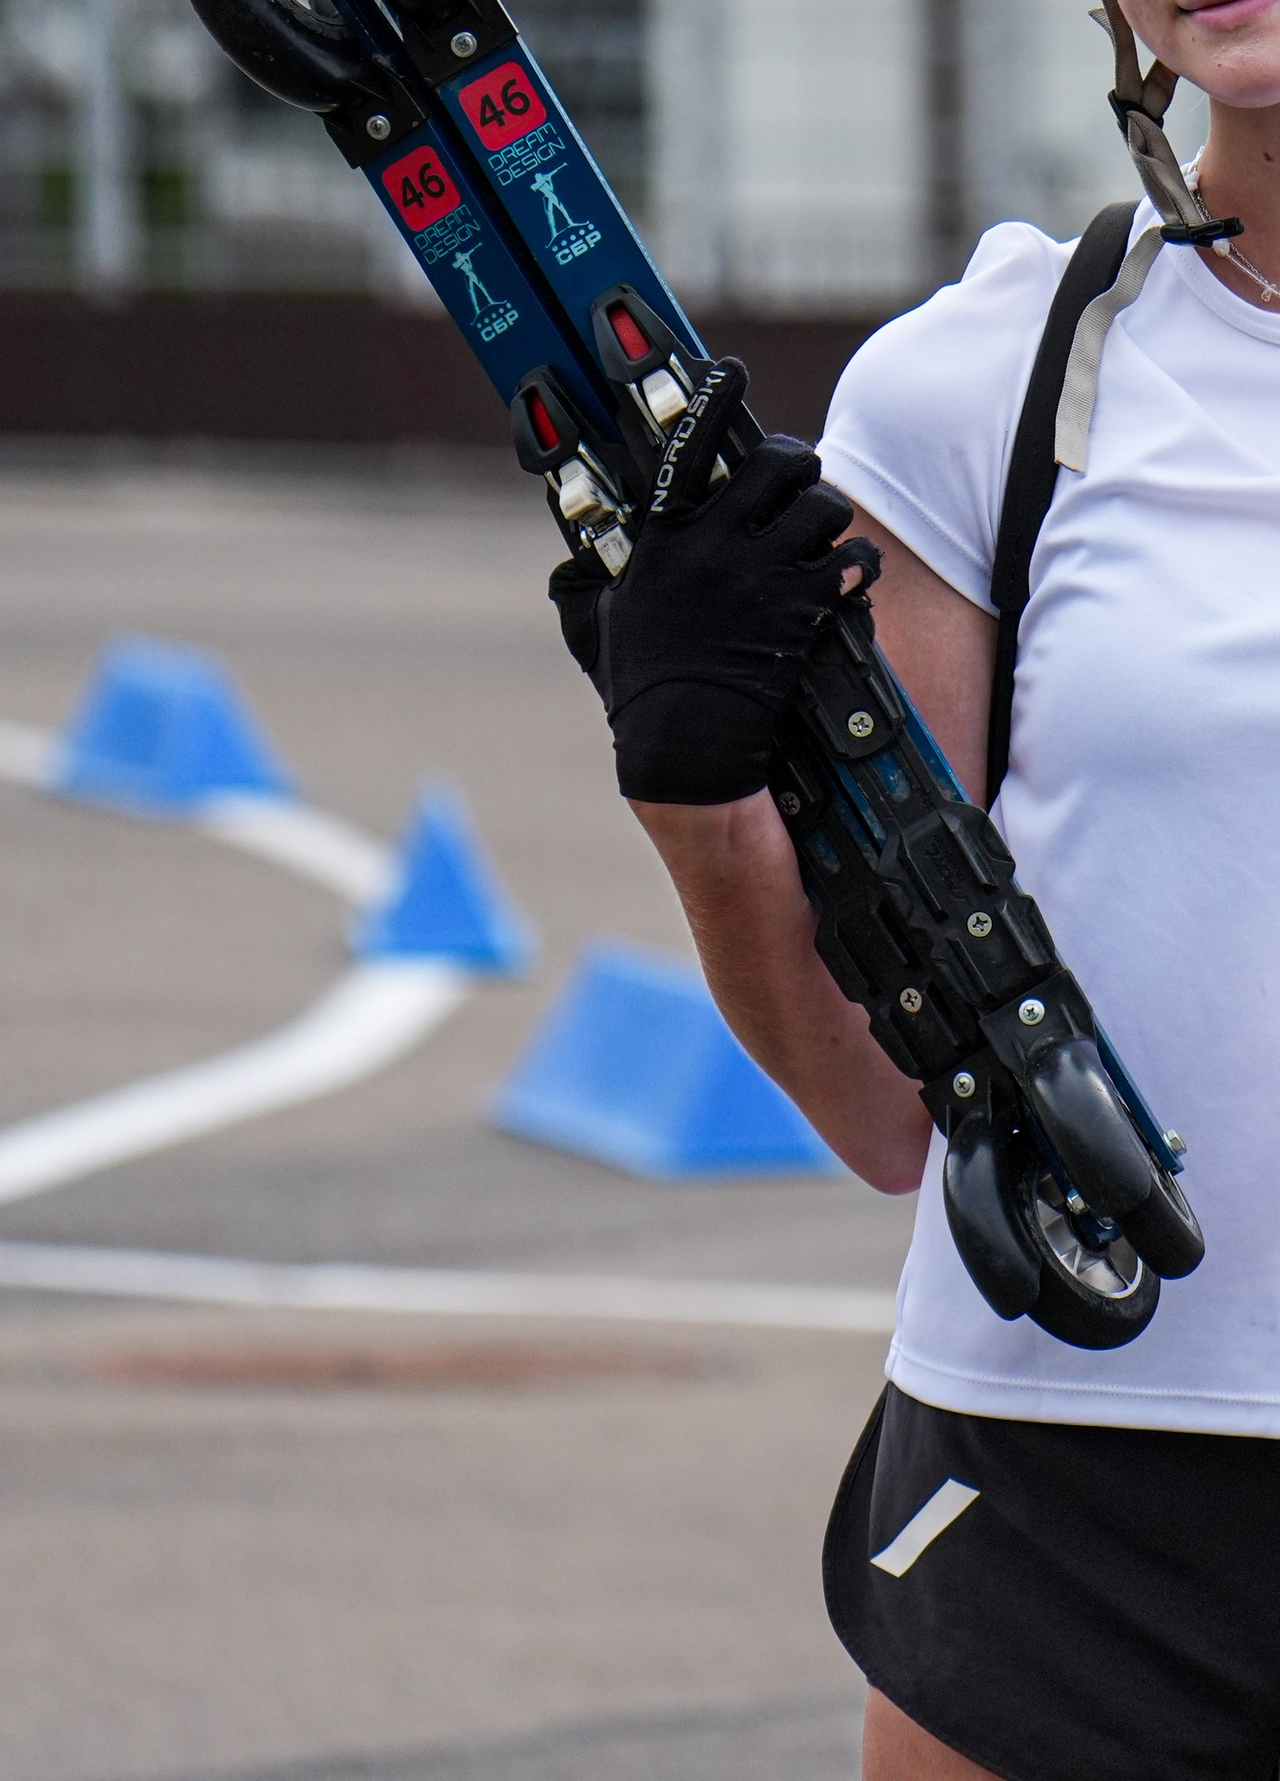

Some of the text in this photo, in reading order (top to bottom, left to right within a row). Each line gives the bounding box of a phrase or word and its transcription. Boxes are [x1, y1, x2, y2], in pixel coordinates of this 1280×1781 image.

[478, 78, 531, 129] 46
[487, 122, 557, 171] DREAM
[496, 136, 566, 186] DESIGN
[401, 161, 446, 209] 46
[414, 204, 472, 250] DREAM
[422, 218, 481, 265] DESIGN
[555, 230, 602, 266] СБР
[480, 309, 519, 342] СБР
[650, 369, 726, 513] NORDSKI
